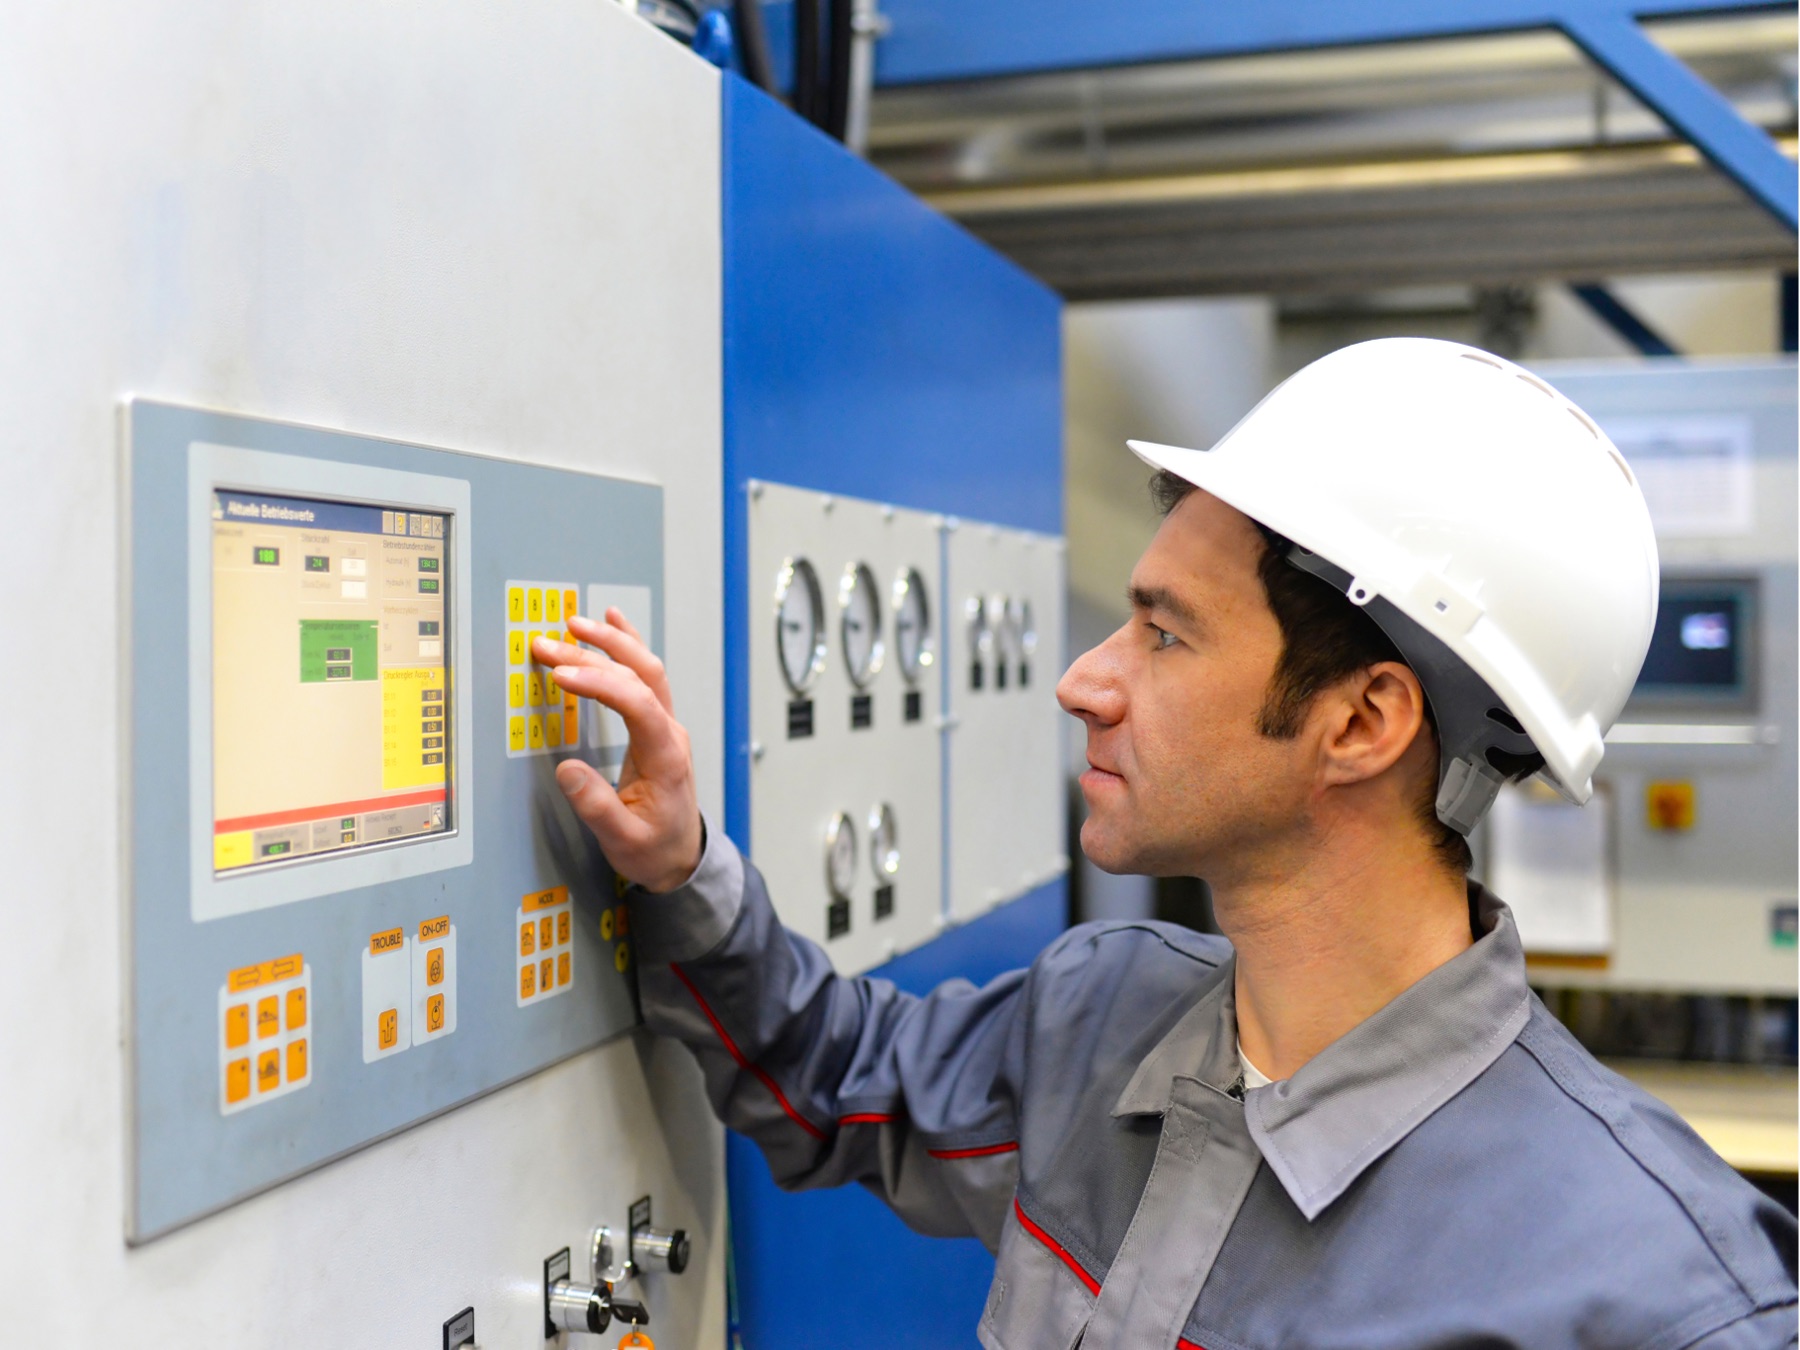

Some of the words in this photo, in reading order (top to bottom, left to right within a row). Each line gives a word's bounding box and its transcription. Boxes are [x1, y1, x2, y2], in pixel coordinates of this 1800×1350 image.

[538, 891, 554, 905] MODE
[422, 920, 447, 937] ON-OFF
[372, 932, 401, 951] TROUBLE
